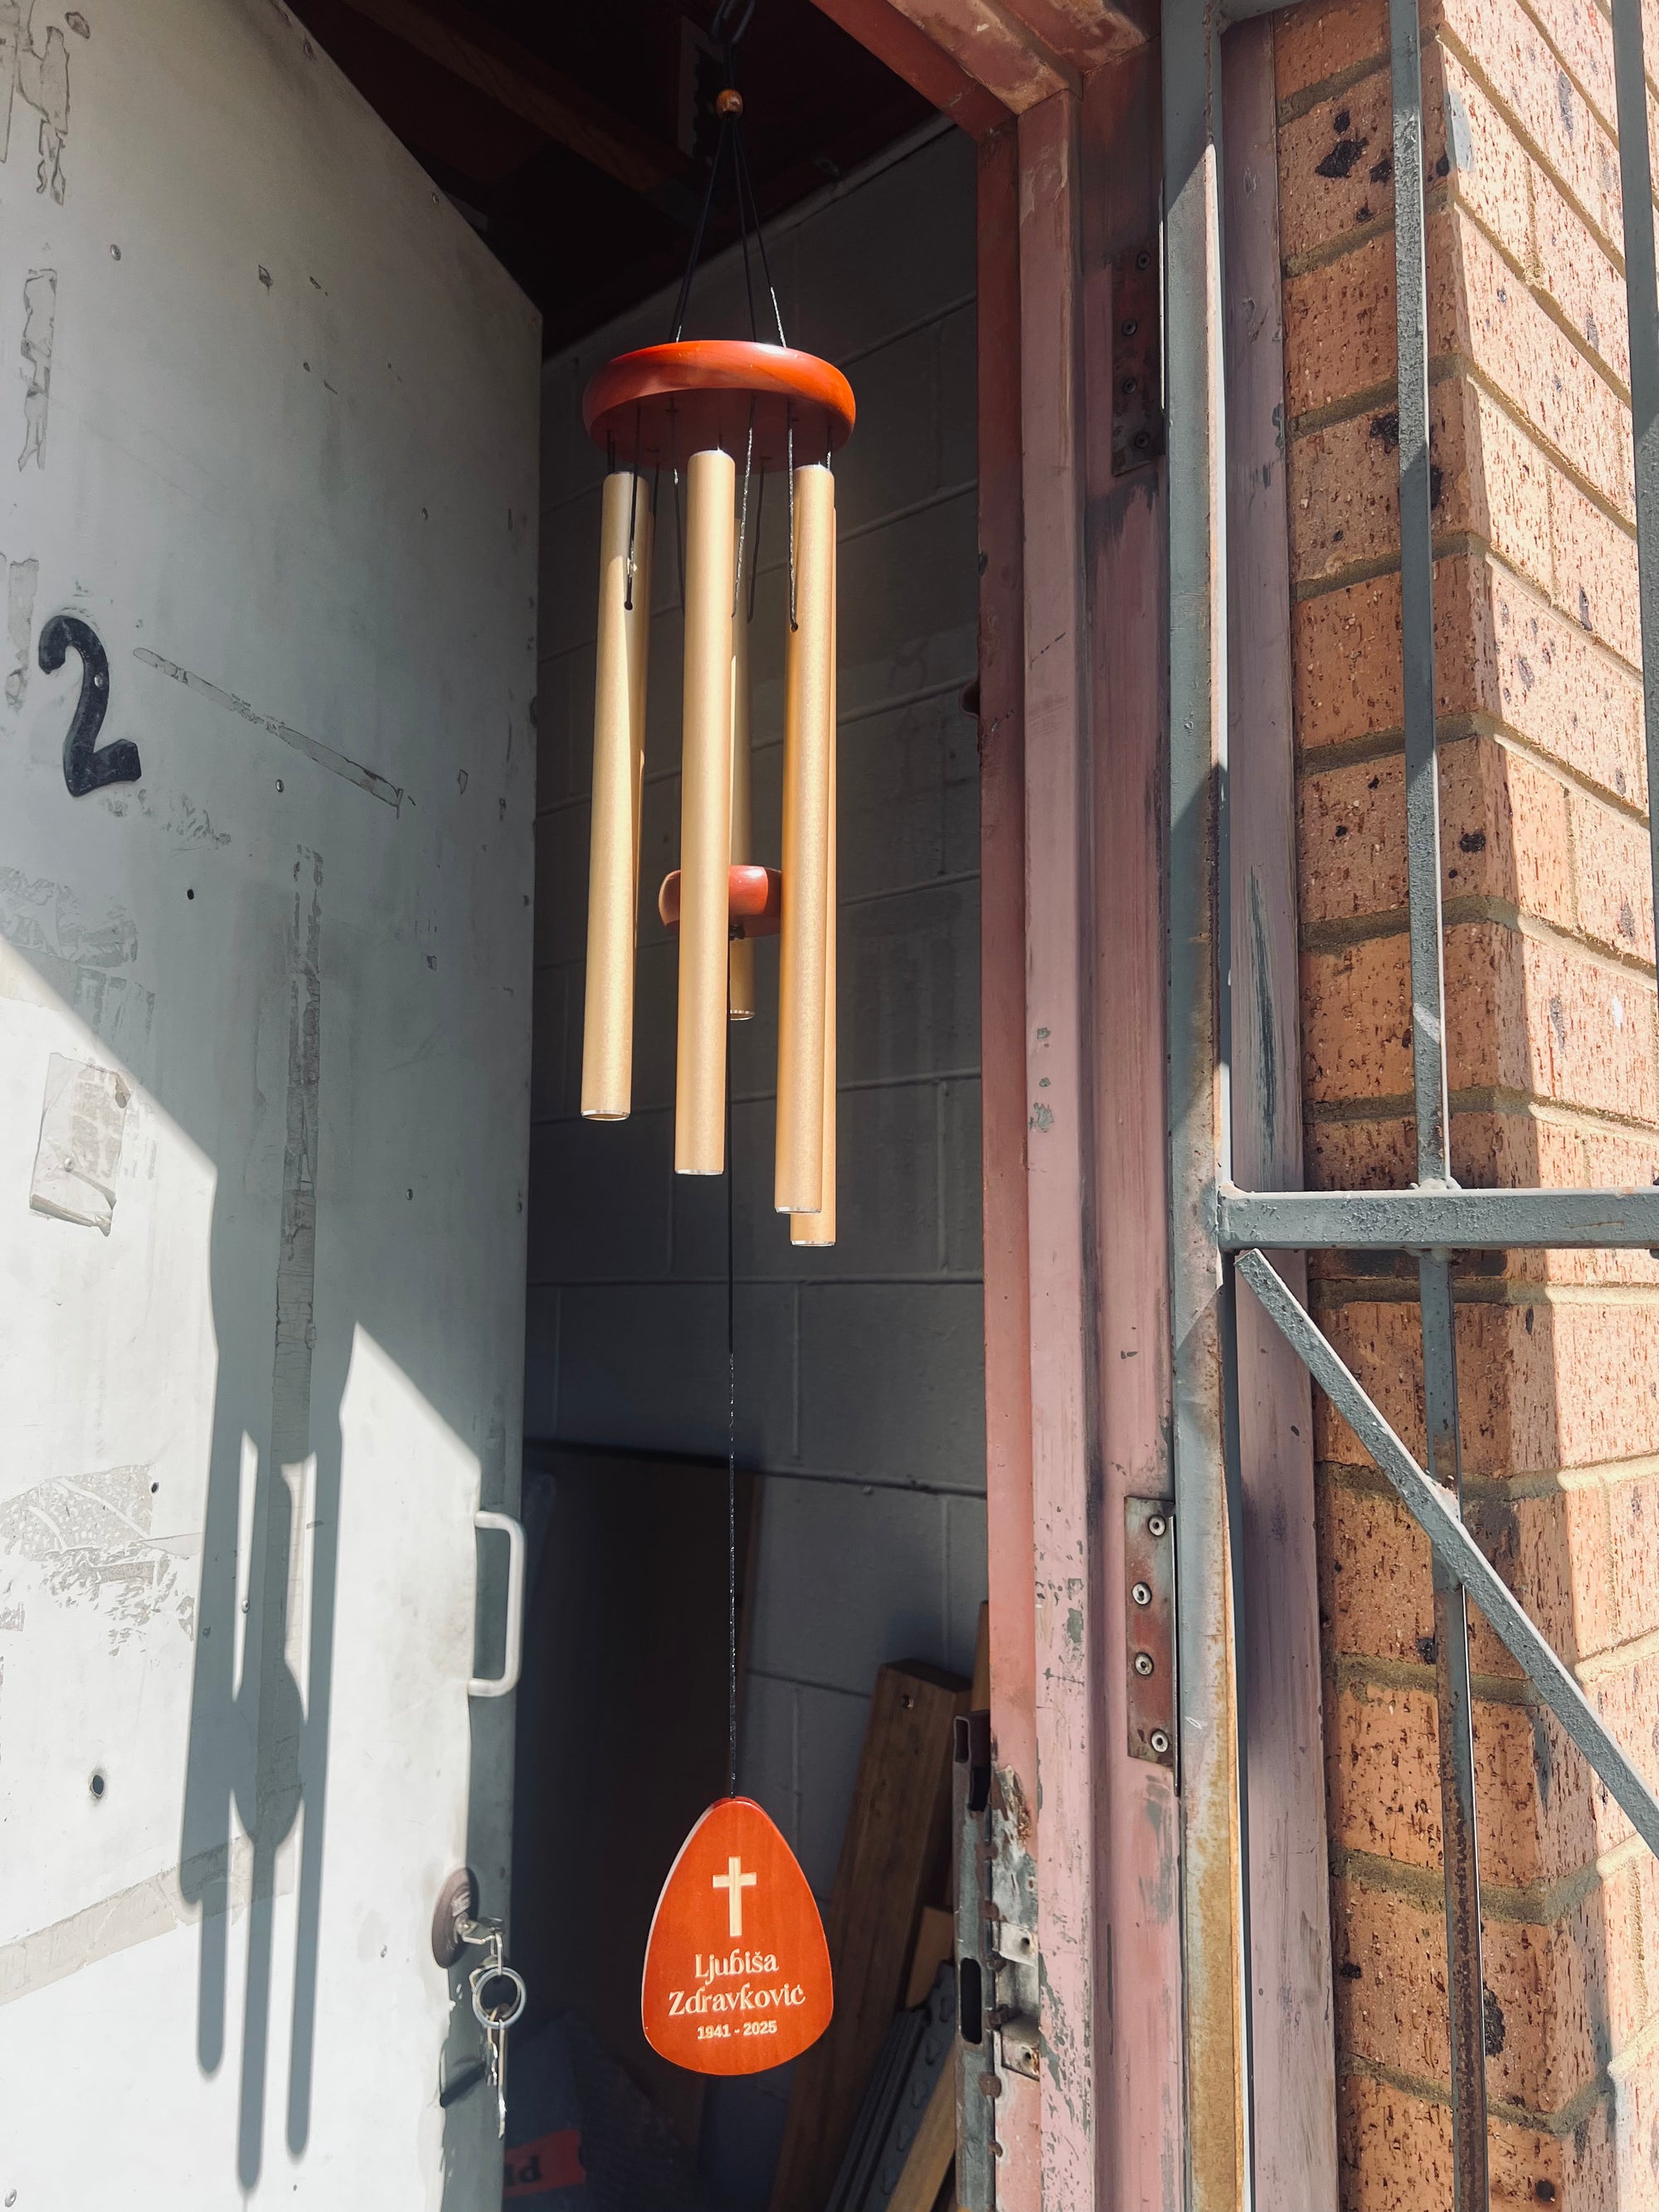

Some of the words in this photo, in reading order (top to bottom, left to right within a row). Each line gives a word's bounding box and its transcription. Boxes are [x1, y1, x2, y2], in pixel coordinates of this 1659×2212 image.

[38, 615, 142, 797] 2
[694, 1949, 779, 1985] Ljubiša
[668, 1983, 806, 2016] Zdravković
[697, 2024, 731, 2040] 1941
[743, 2020, 778, 2036] 2025
